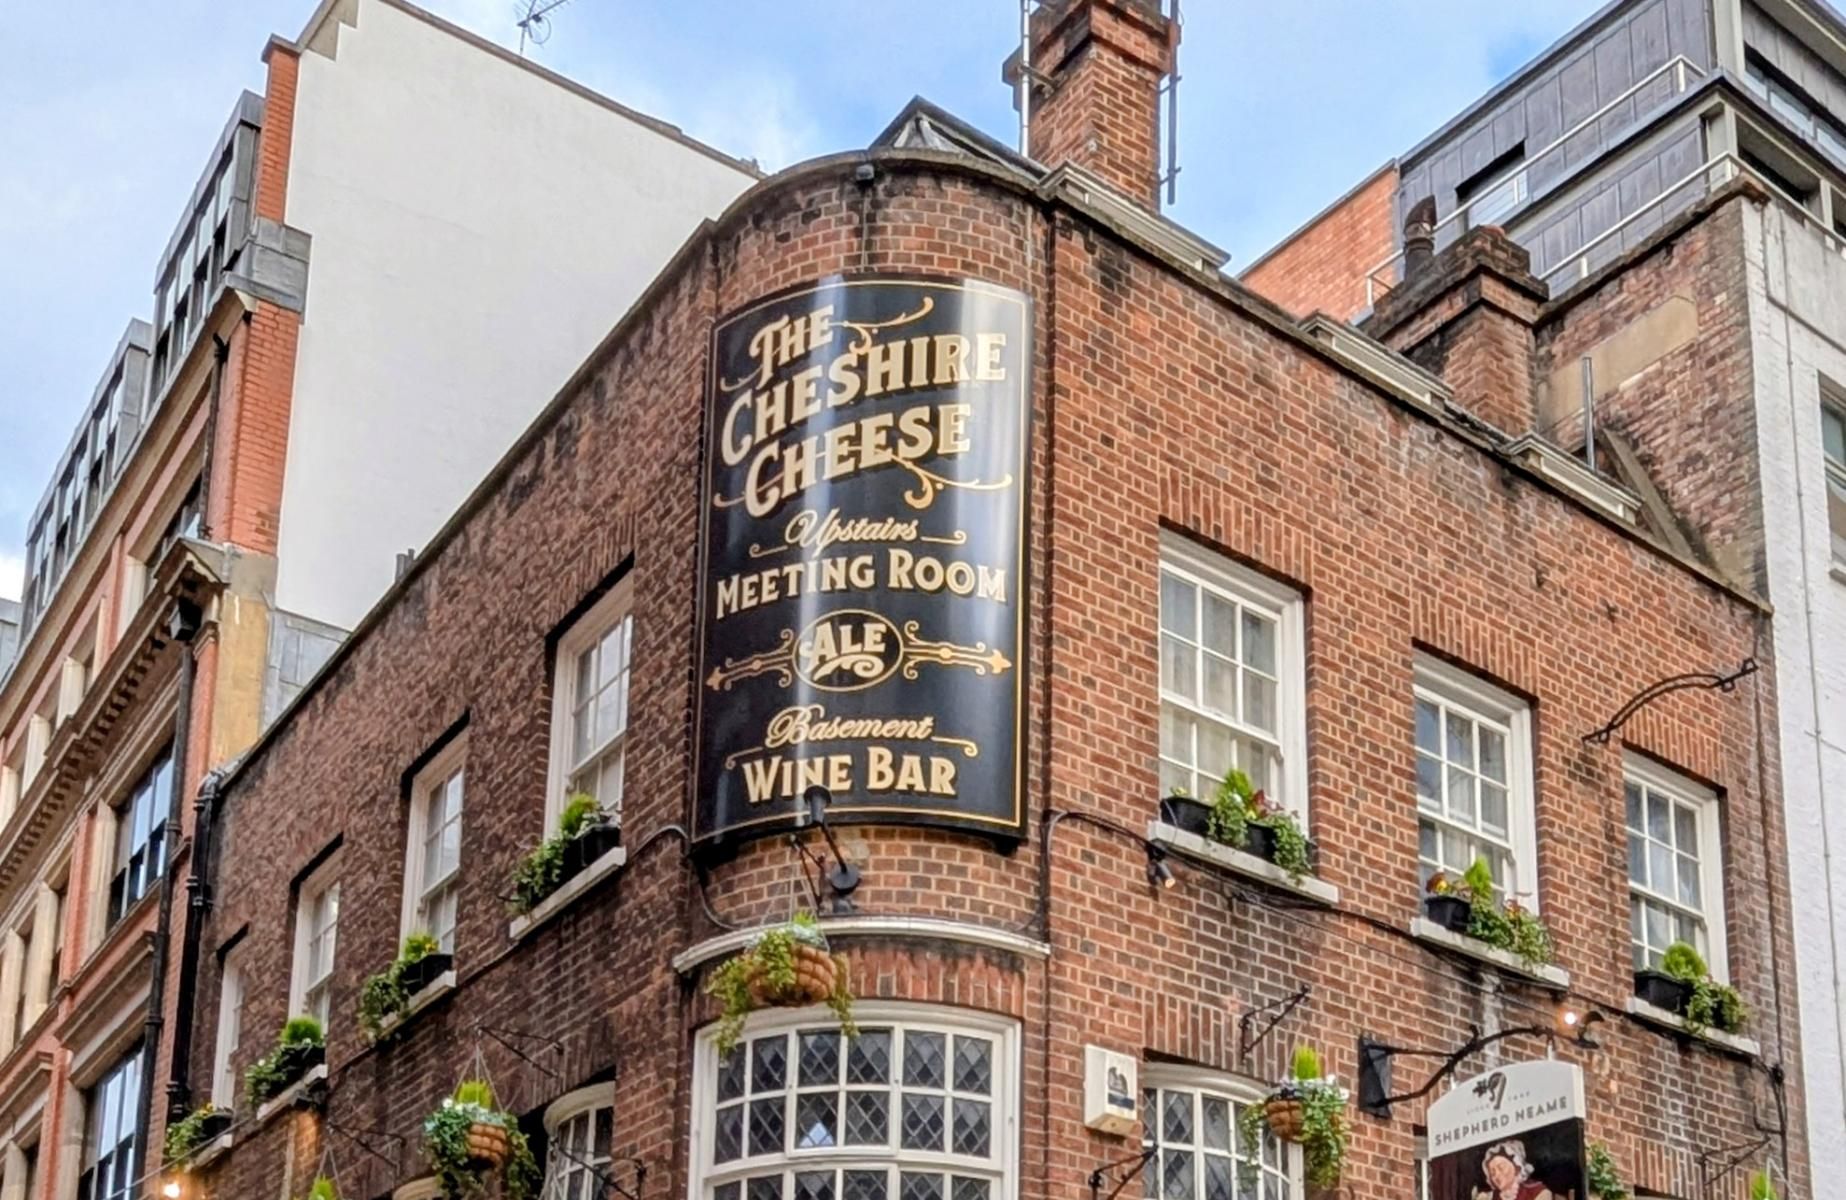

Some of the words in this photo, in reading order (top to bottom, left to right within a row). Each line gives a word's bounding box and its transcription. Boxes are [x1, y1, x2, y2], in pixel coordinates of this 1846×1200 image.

[721, 332, 1007, 467] CHESHIRE
[745, 403, 971, 517] CHEESE
[785, 508, 919, 557] Upstairs
[716, 554, 875, 619] MEETING
[887, 548, 1008, 602] ROOM
[798, 621, 887, 674] ALE
[765, 704, 934, 748] Basement
[742, 754, 852, 803] WINE
[866, 746, 956, 795] BAR
[1434, 1115, 1510, 1146] SHEPHERD
[1515, 1096, 1568, 1125] NEAME
